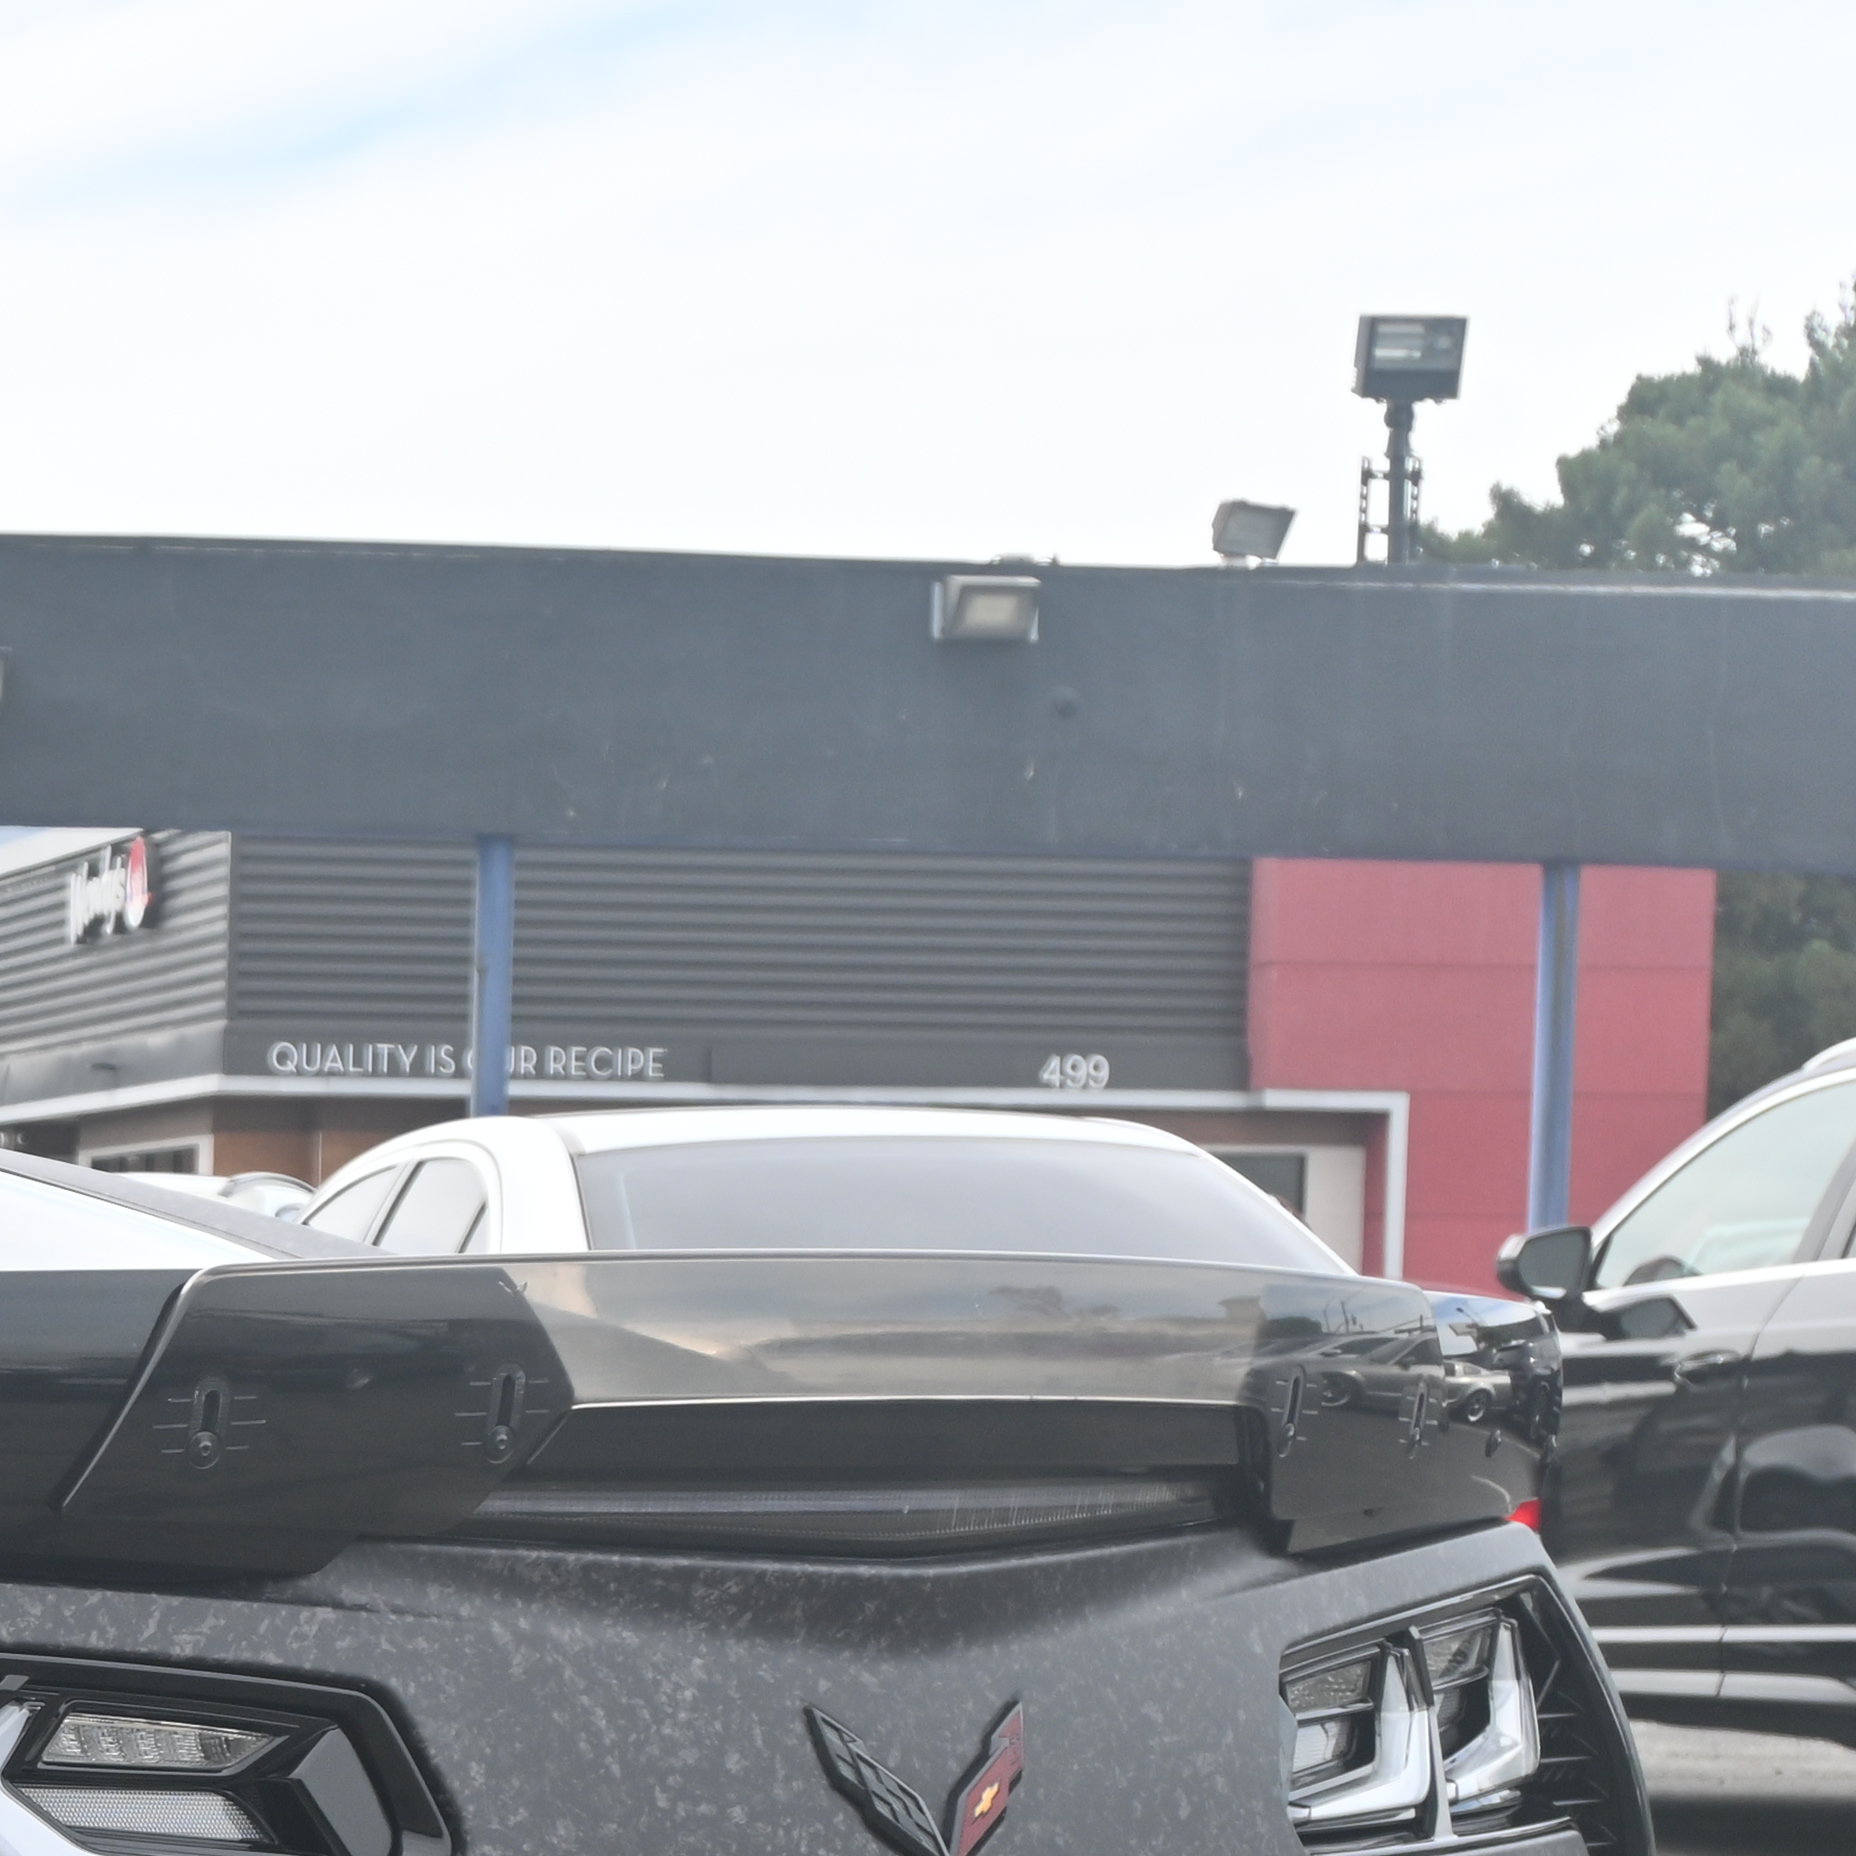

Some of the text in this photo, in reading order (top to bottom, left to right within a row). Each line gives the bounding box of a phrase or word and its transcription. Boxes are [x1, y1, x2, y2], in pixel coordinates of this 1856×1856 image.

[269, 1041, 418, 1074] QUALITY
[427, 1044, 456, 1075] IS
[546, 1046, 667, 1077] RECIPE
[1041, 1053, 1110, 1089] 499
